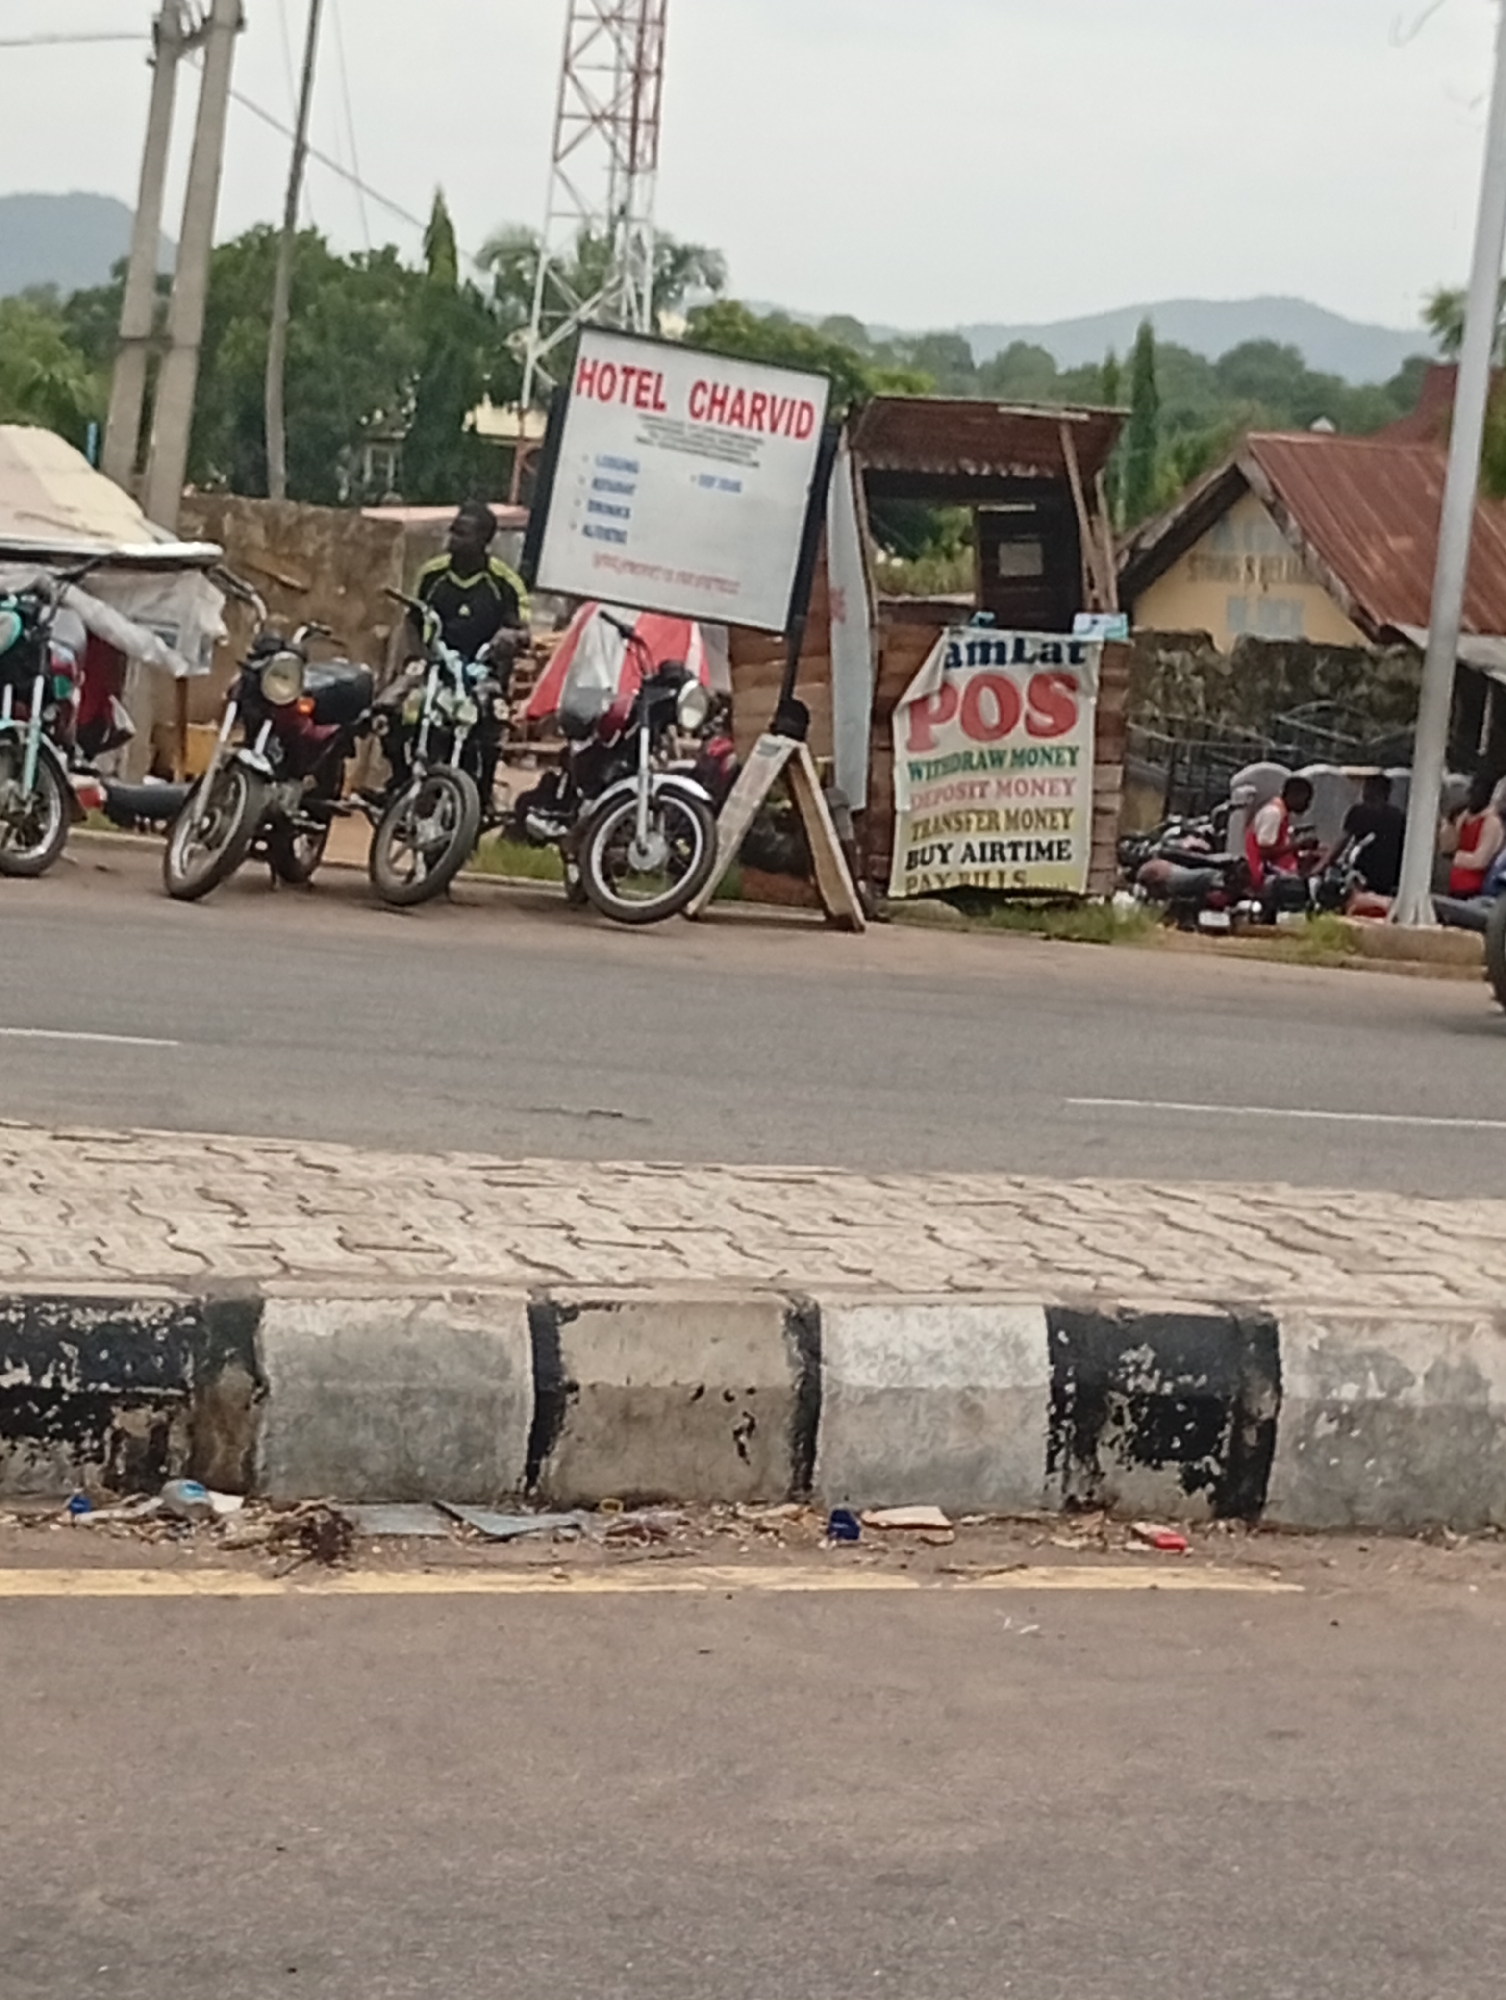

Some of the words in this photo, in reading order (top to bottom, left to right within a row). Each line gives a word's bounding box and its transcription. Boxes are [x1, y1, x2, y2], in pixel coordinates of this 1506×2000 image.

[576, 357, 666, 411] HOTEL
[688, 379, 815, 439] CHARVID
[944, 637, 1086, 669] amLat
[906, 671, 1079, 752] POS
[908, 750, 1006, 782] WITHDRAW
[1010, 746, 1079, 767] MONEY
[910, 780, 990, 811] DEPOSIT
[996, 777, 1075, 798] MONEY
[911, 808, 999, 842] TRANSFER
[1004, 807, 1074, 830] MONEY
[906, 842, 953, 870] BUY
[960, 838, 1072, 864] AIRTIME
